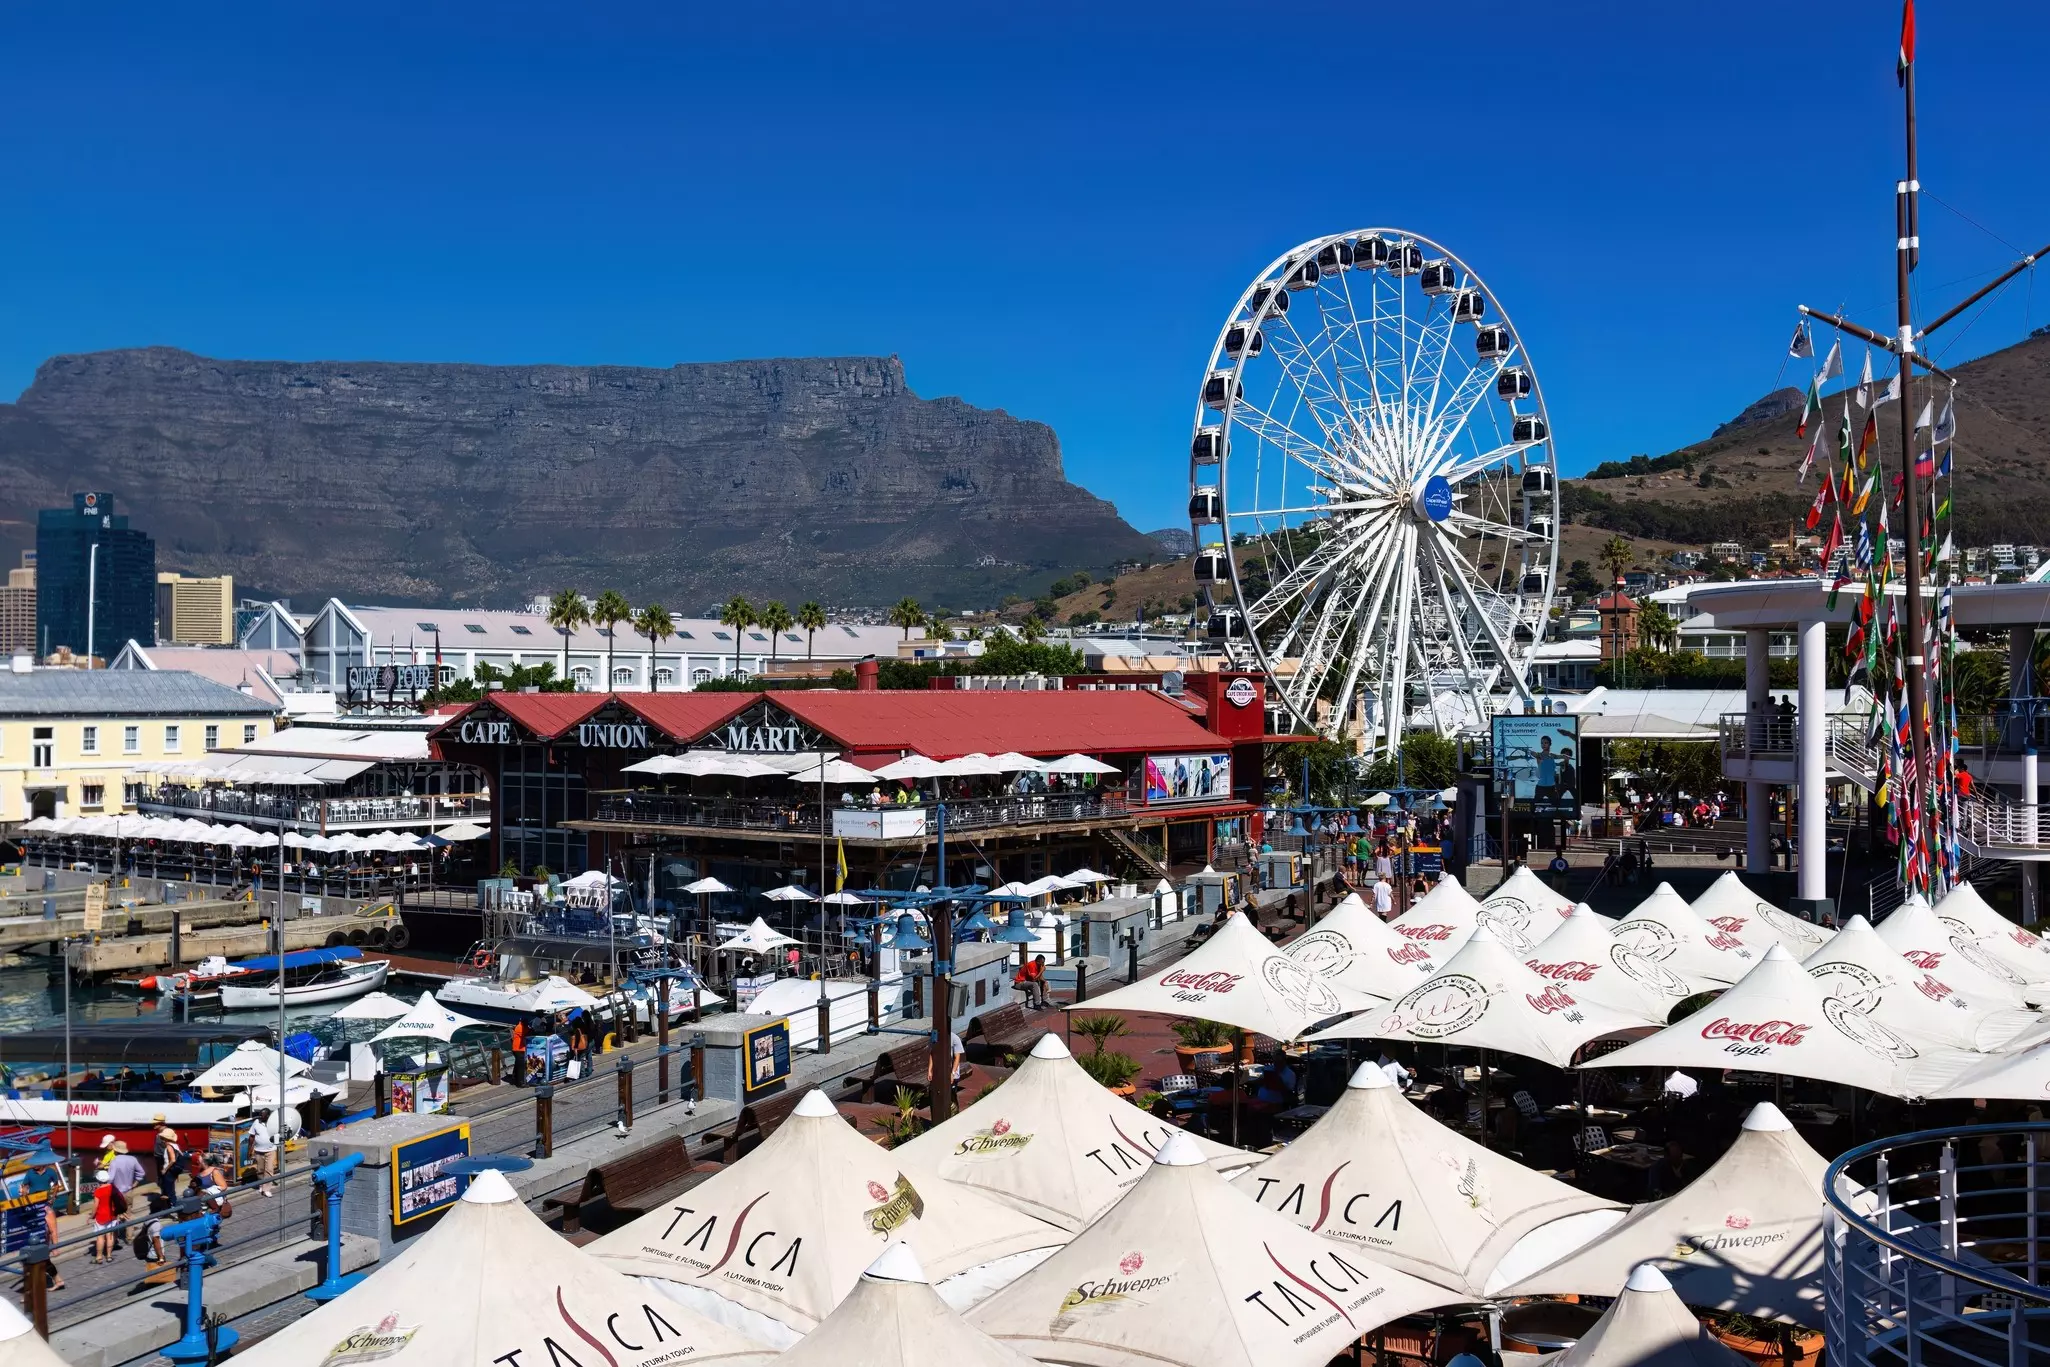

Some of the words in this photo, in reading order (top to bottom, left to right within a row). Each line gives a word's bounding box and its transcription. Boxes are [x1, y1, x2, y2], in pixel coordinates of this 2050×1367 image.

[84, 507, 98, 515] FNB
[349, 666, 379, 690] QUAY
[397, 665, 430, 689] FOUR
[461, 722, 511, 744] CAPE
[579, 723, 648, 748] UNION
[726, 726, 800, 751] MART
[1160, 968, 1245, 993] Coca-Cola
[1450, 978, 1466, 986] WINE
[1467, 983, 1477, 994] BAR
[1171, 990, 1206, 1002] light
[397, 1021, 434, 1029] bonaqua
[1415, 1025, 1434, 1034] GRILL
[1701, 1017, 1813, 1046] Coca-Cola
[1722, 1043, 1770, 1056] light
[66, 1103, 98, 1116] DAWN
[954, 1134, 1029, 1156] Schweppes
[1457, 1156, 1478, 1209] Schweppes
[1256, 1160, 1402, 1232] TASCA
[661, 1191, 802, 1279] TASCA
[1332, 1230, 1367, 1242] LATURKA
[1367, 1236, 1393, 1246] TOUCH
[1680, 1231, 1784, 1256] Schweppes
[680, 1255, 711, 1270] FLAVOUR
[731, 1272, 761, 1288] LATURKA
[760, 1280, 784, 1292] TOUCH
[1244, 1240, 1369, 1330] TASCA
[1068, 1274, 1173, 1306] Schweppes
[1351, 1294, 1372, 1310] LATURKA
[1369, 1286, 1386, 1300] TOUCH
[670, 1345, 694, 1359] TOUCH
